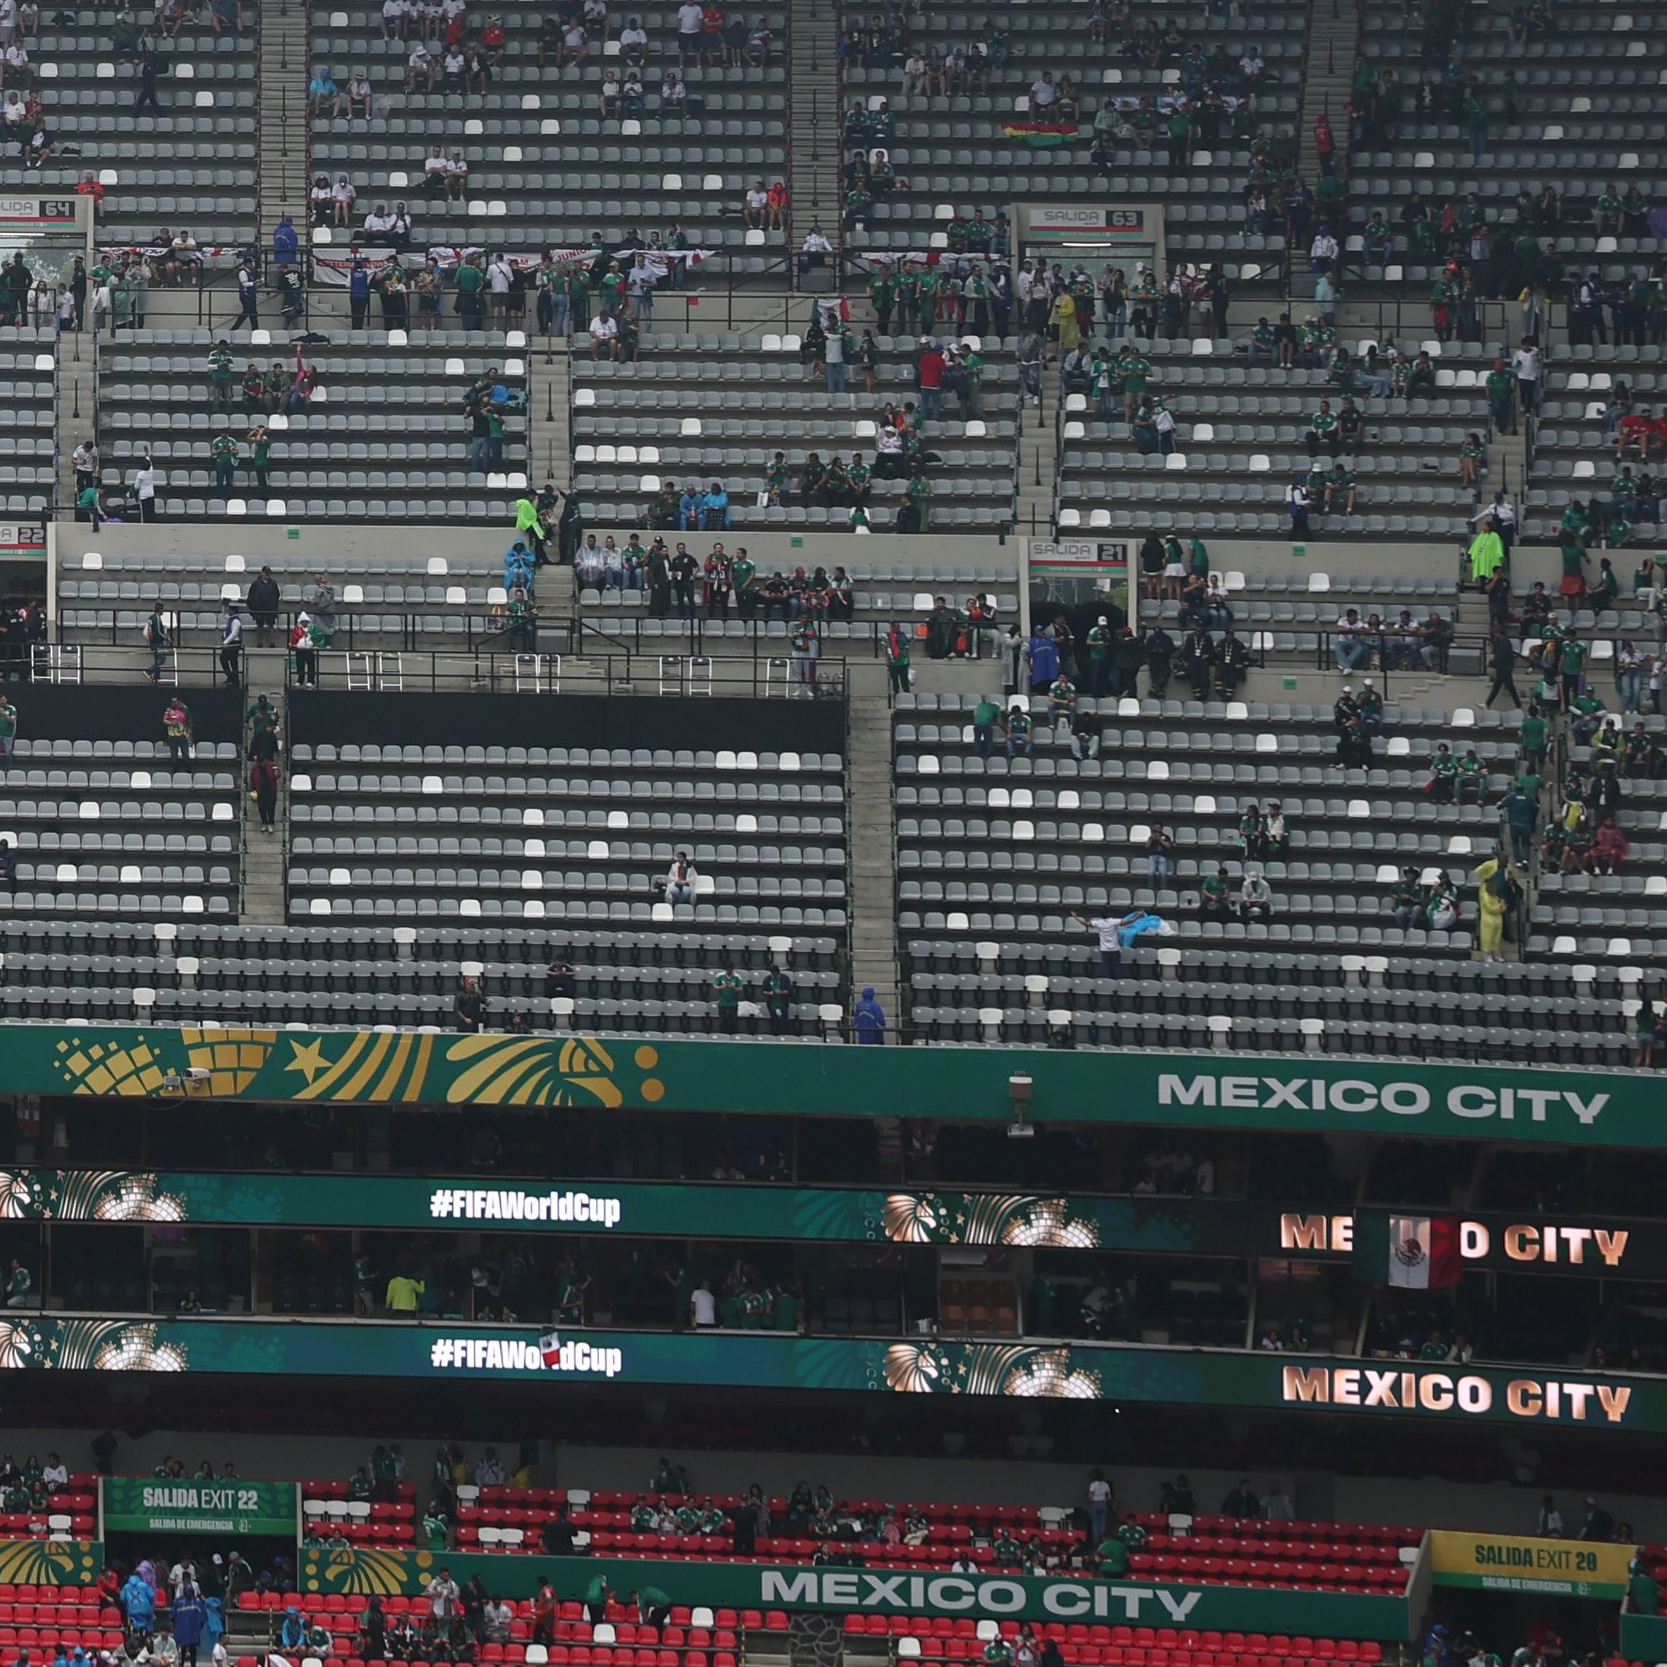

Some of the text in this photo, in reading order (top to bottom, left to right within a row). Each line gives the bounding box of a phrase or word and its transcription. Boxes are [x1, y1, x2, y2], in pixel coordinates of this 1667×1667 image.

[45, 202, 69, 216] 64
[1045, 211, 1137, 226] SALIDA 63
[20, 528, 44, 543] 22
[1034, 544, 1123, 560] SALIDA 21
[1159, 1074, 1610, 1123] MEXICO CITY
[430, 1190, 620, 1227] #FIFAWorldCup
[1505, 1226, 1628, 1265] CITY
[431, 1338, 622, 1376] #FIFAWodCup
[1283, 1367, 1631, 1421] MEXICO CITY
[143, 1487, 258, 1510] SALIDA EXIT 22
[150, 1519, 233, 1531] SALIDA DE EMERGENCIA
[1475, 1545, 1533, 1567] SALIDA
[1537, 1549, 1572, 1570] EXIT
[761, 1571, 1203, 1621] MEXICO CITY
